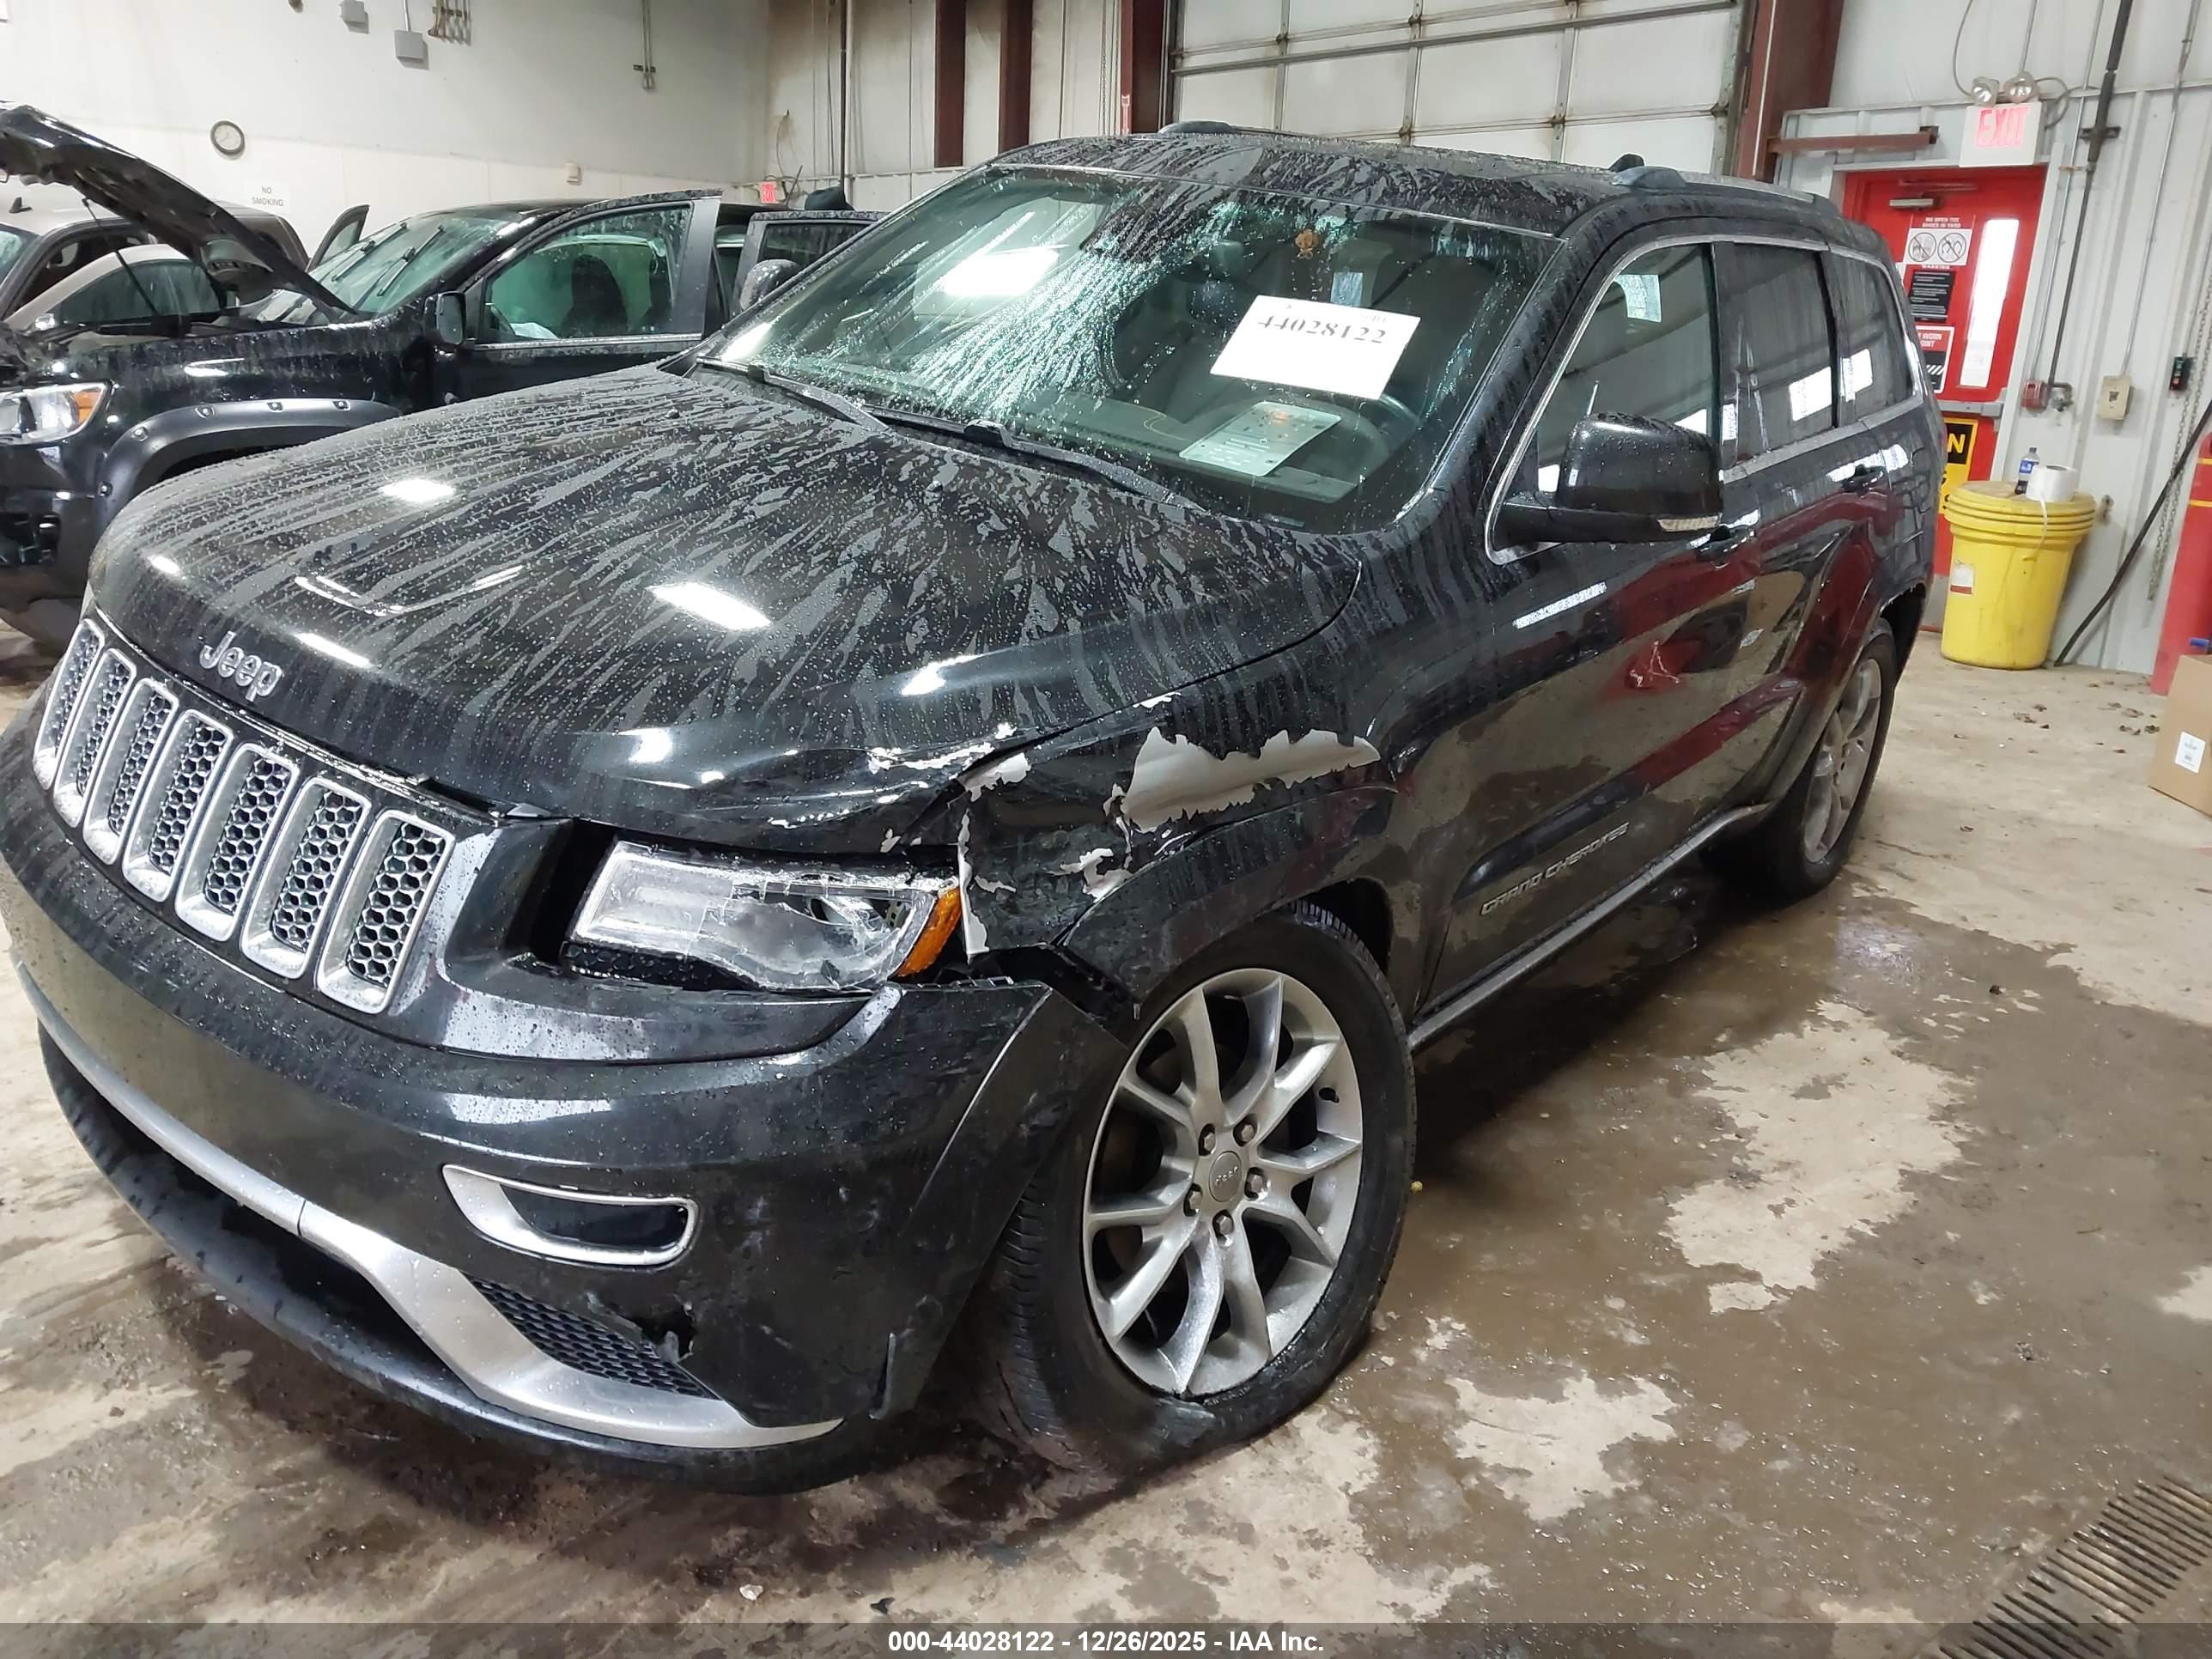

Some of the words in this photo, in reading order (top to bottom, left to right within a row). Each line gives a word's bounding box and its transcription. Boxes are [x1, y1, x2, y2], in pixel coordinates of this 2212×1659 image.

[1977, 108, 2028, 147] EXIT
[252, 197, 283, 206] SMOKING
[1258, 315, 1387, 343] 44028122
[199, 630, 285, 702] Jeep
[1479, 872, 1543, 916] GRAND
[1545, 820, 1630, 879] CHEROKEE
